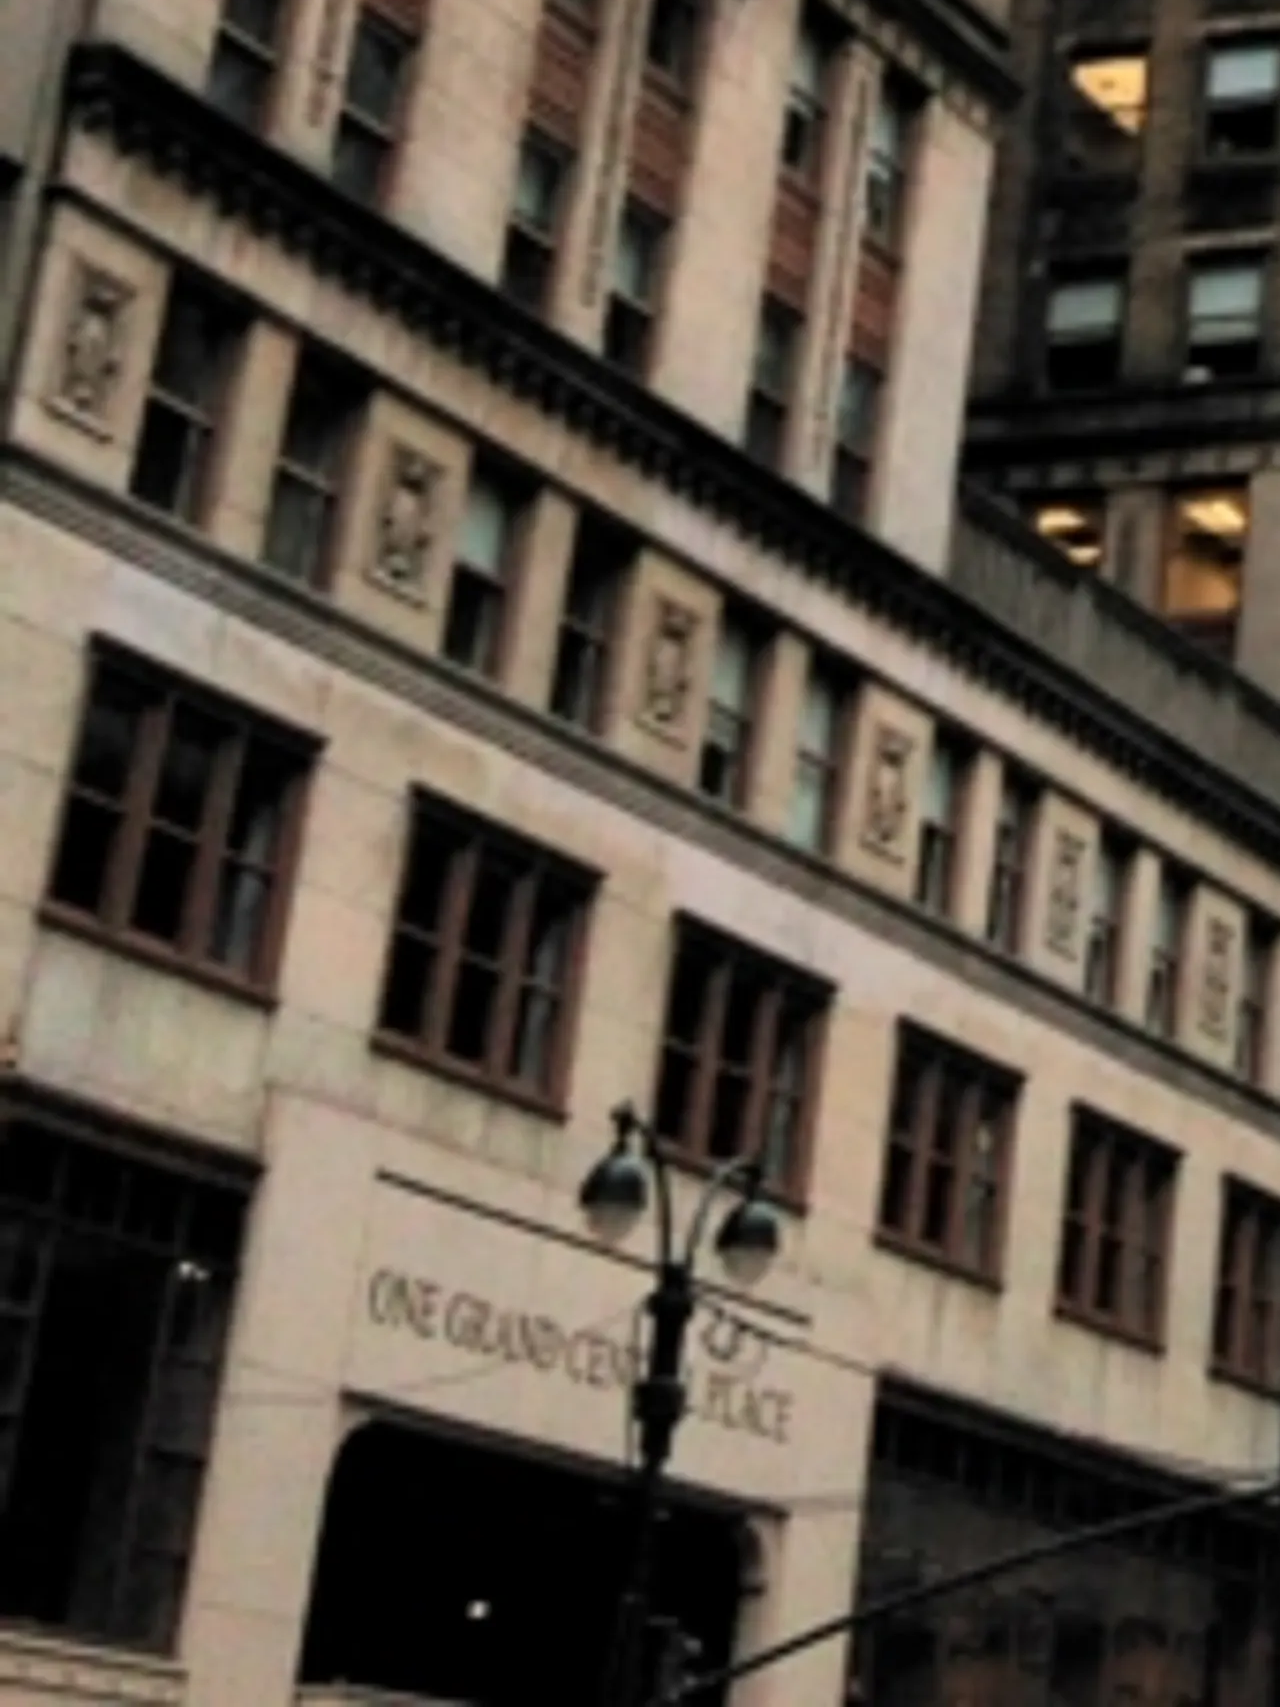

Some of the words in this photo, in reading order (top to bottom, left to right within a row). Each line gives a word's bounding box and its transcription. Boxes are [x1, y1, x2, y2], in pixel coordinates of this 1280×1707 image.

[368, 1267, 442, 1340] ONE
[446, 1290, 566, 1373] GRAND
[703, 1370, 794, 1446] PLACE
